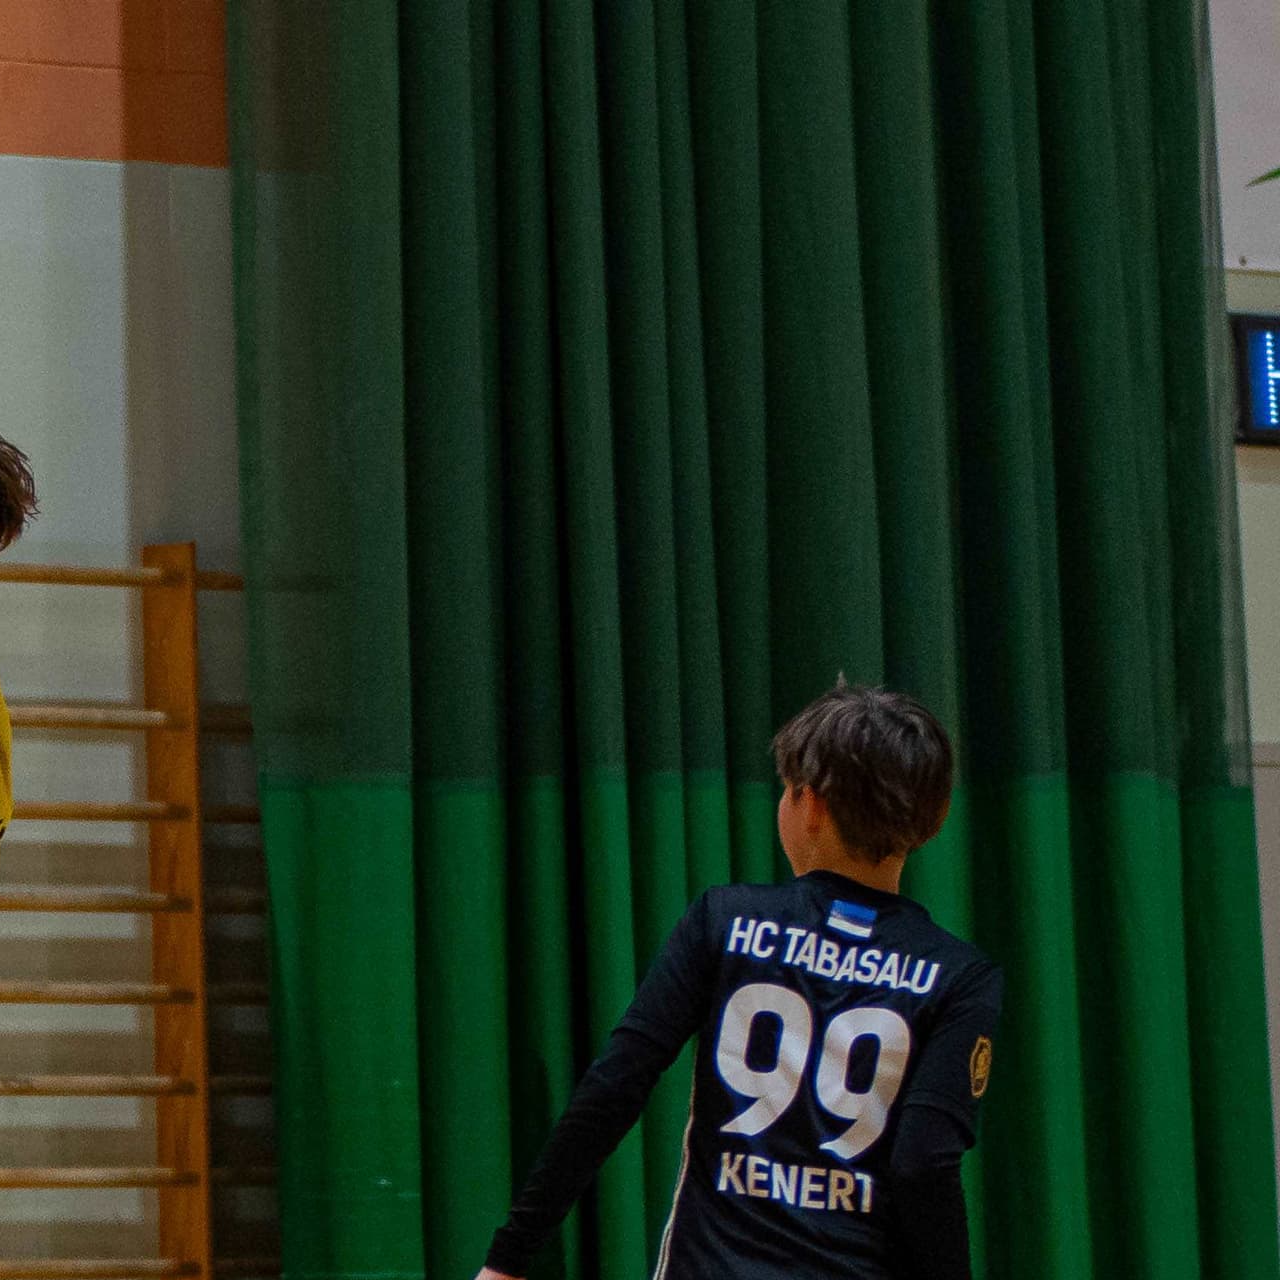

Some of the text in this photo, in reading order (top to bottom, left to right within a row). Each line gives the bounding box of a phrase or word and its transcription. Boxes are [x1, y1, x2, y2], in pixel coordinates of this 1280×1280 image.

[725, 916, 940, 994] HC TABASALU
[716, 982, 911, 1160] 99
